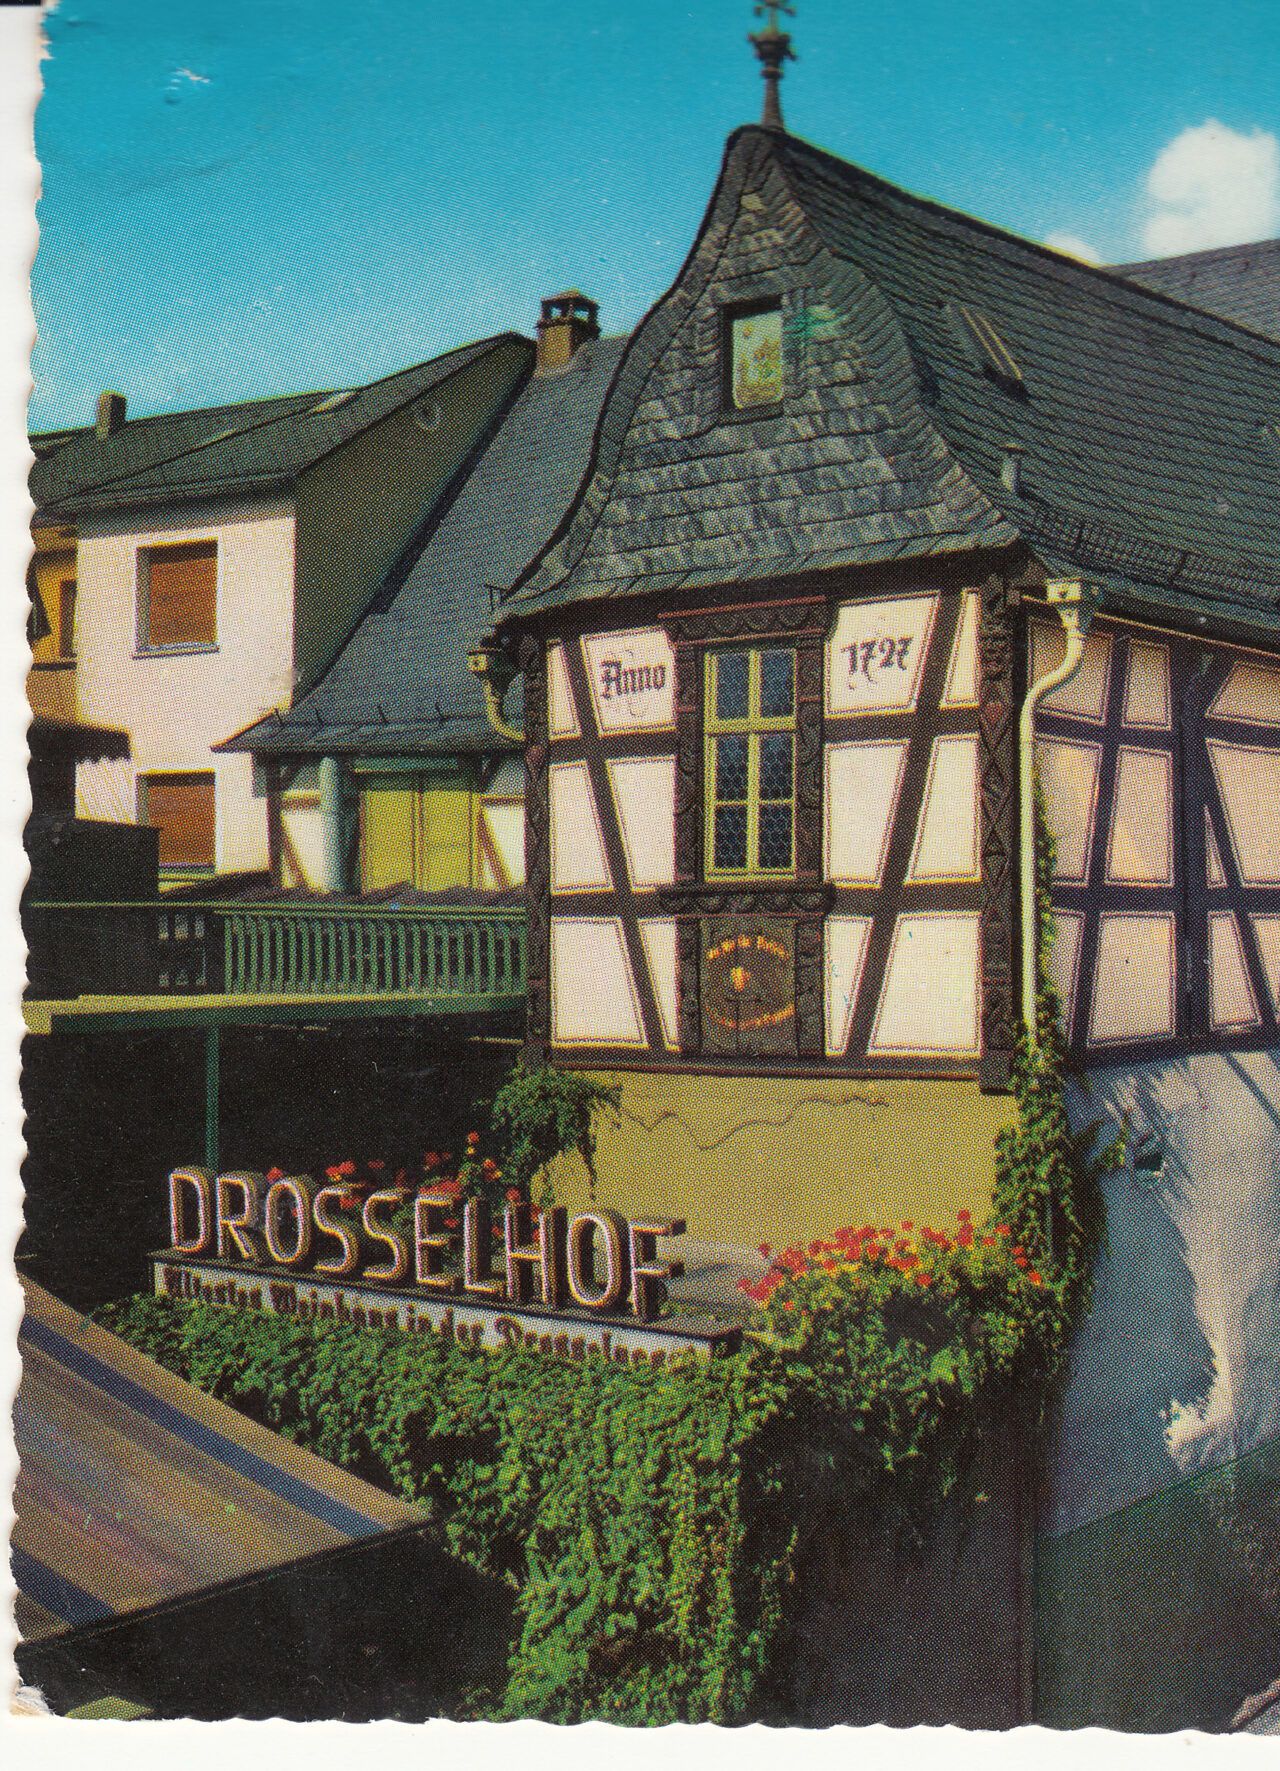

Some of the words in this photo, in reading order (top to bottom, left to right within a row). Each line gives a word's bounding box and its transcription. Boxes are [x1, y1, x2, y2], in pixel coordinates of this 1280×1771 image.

[600, 659, 666, 700] Anno
[840, 636, 914, 687] 1727
[168, 1166, 689, 1323] DROSSELHOF
